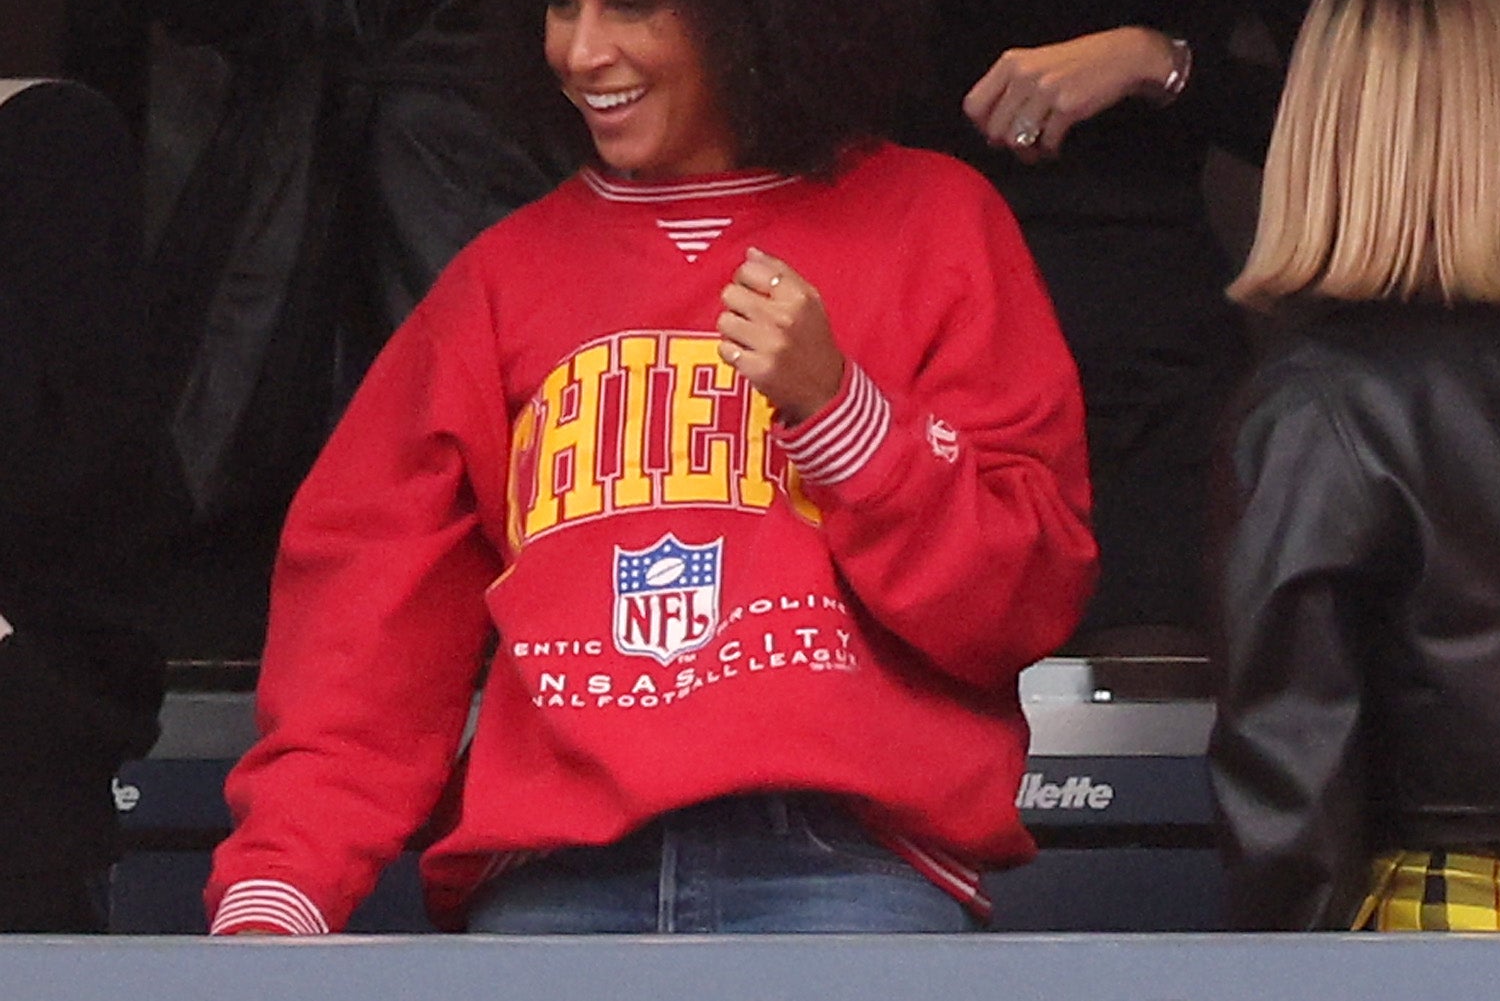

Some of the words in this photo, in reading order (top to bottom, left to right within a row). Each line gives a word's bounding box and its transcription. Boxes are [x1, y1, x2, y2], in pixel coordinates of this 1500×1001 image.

[507, 330, 822, 556] CHIE
[620, 589, 711, 650] NFL
[719, 628, 850, 662] CITY
